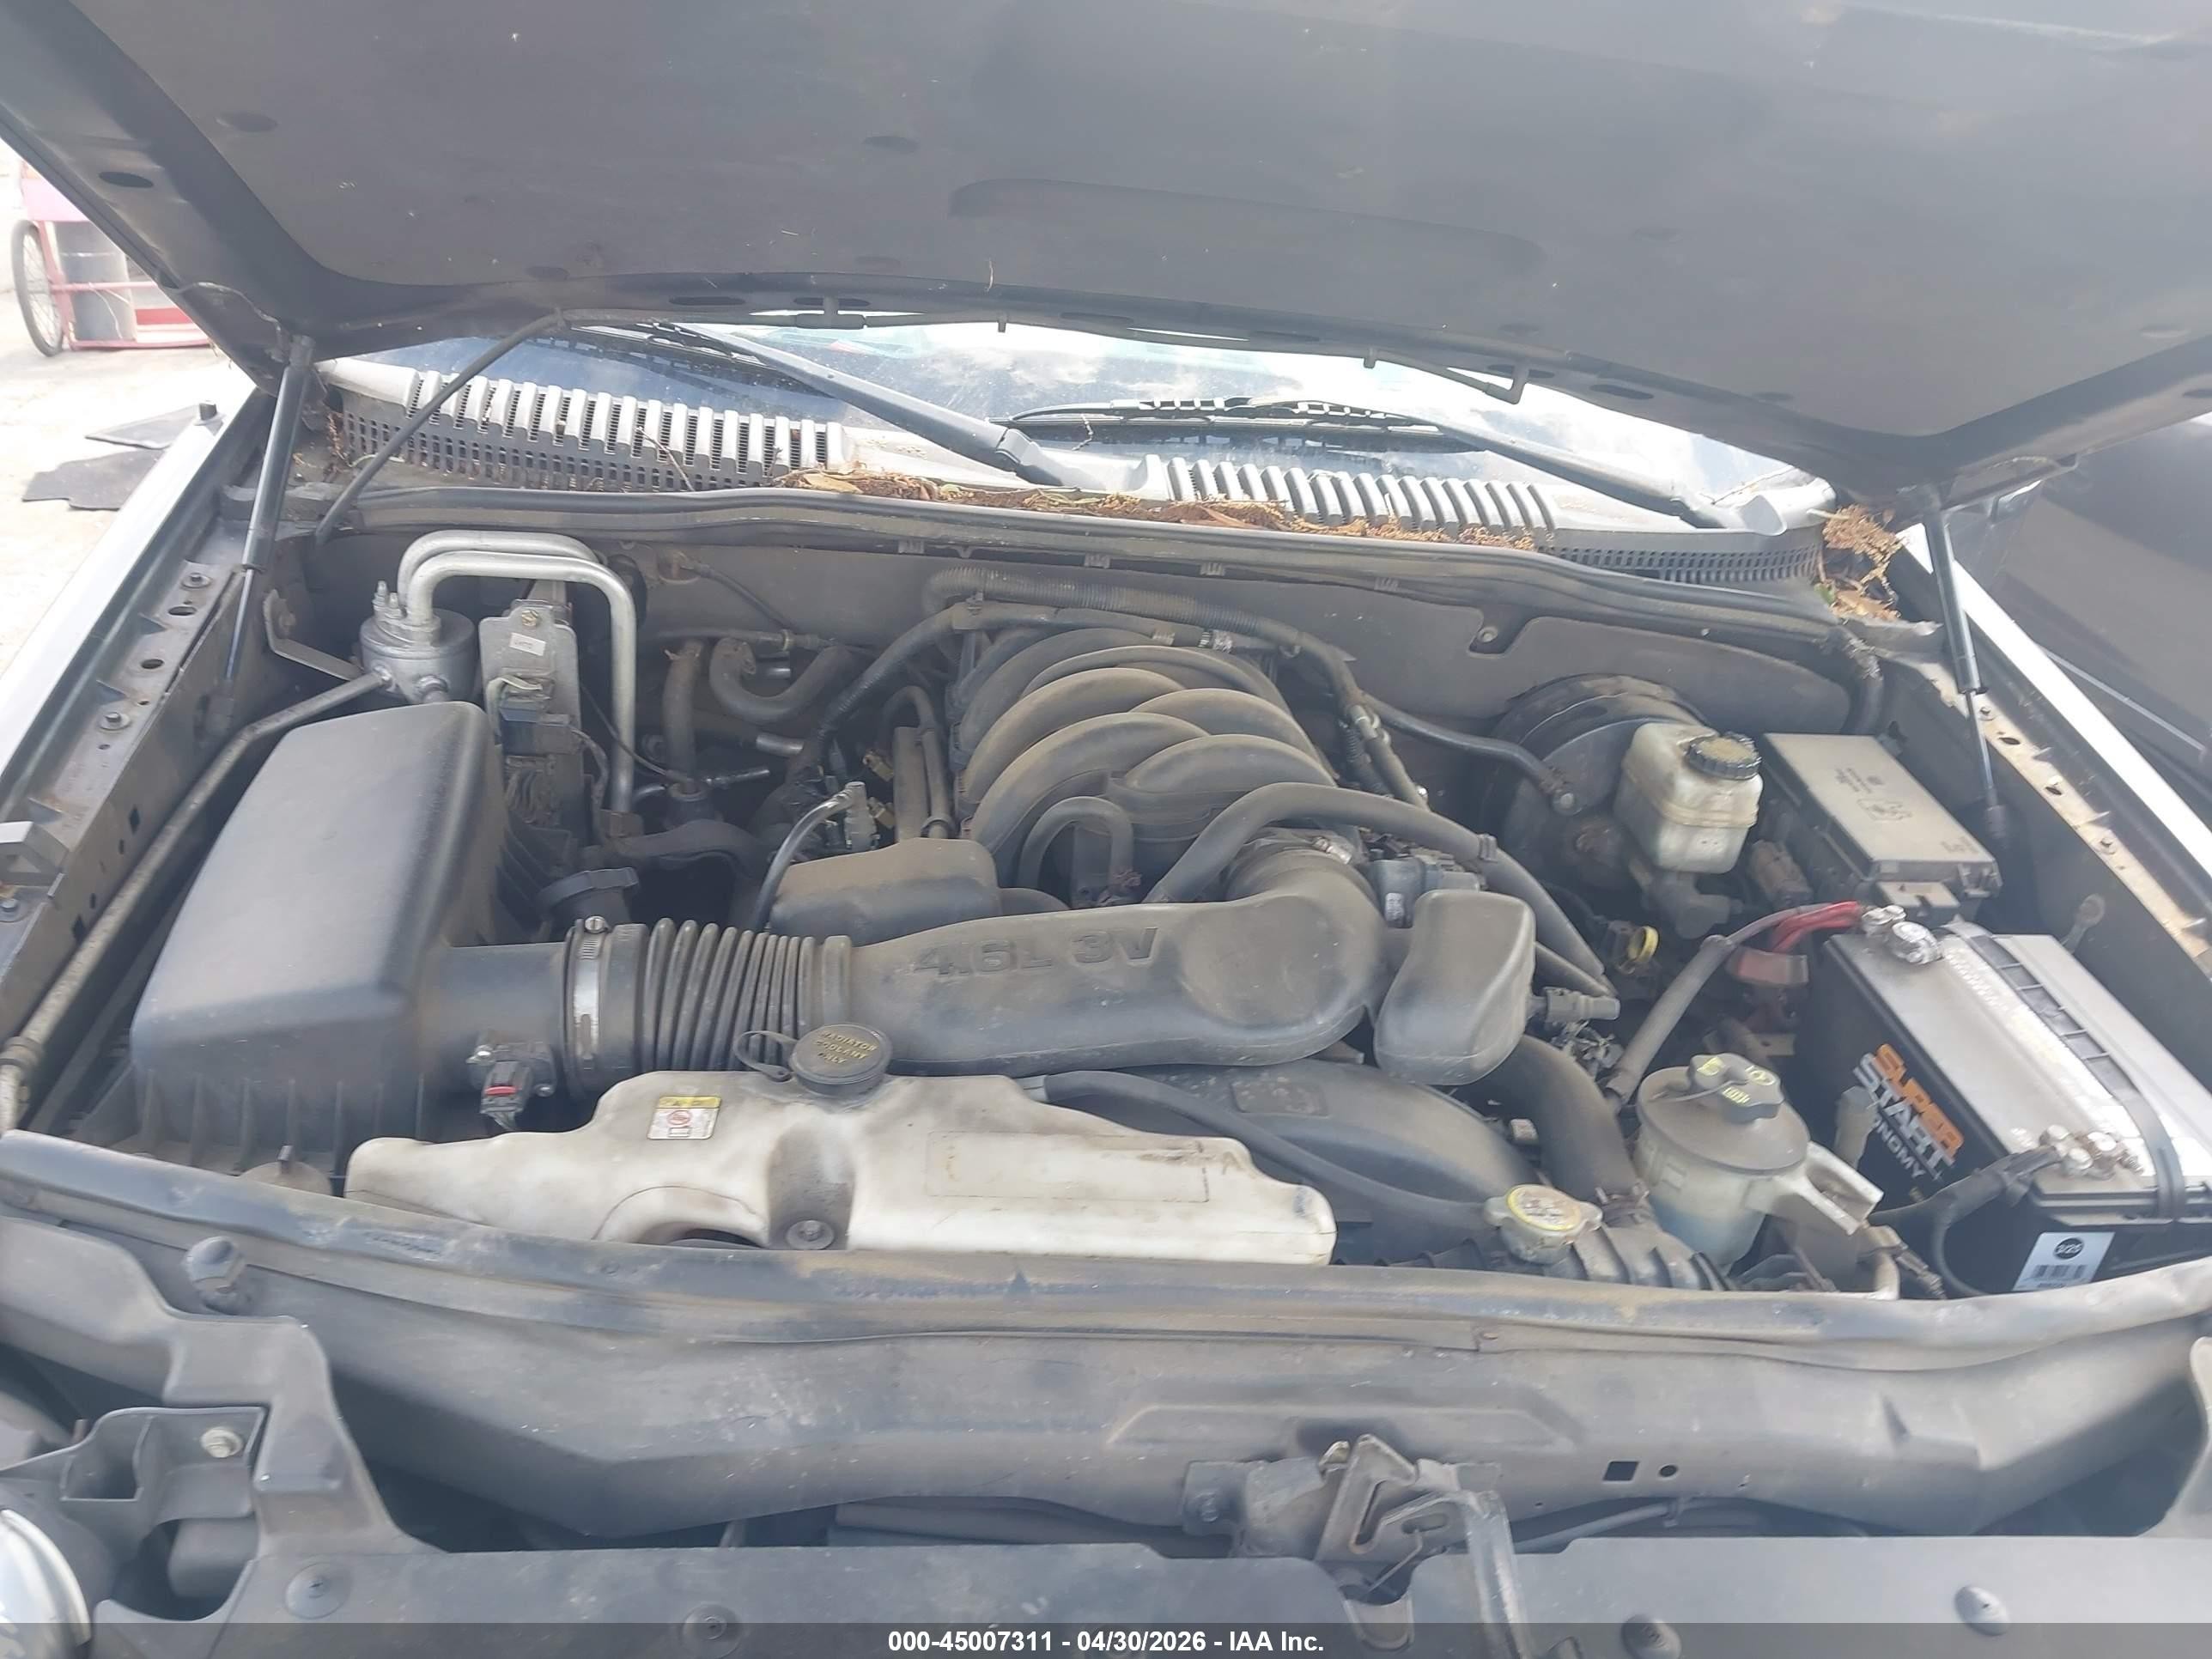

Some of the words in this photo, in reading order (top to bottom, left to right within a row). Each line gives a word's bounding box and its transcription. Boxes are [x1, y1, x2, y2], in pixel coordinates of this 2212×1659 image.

[912, 942, 1053, 975] 4.6L
[1071, 927, 1159, 965] 3V
[1852, 1052, 1955, 1170] START
[1875, 1043, 1964, 1159] SUPER
